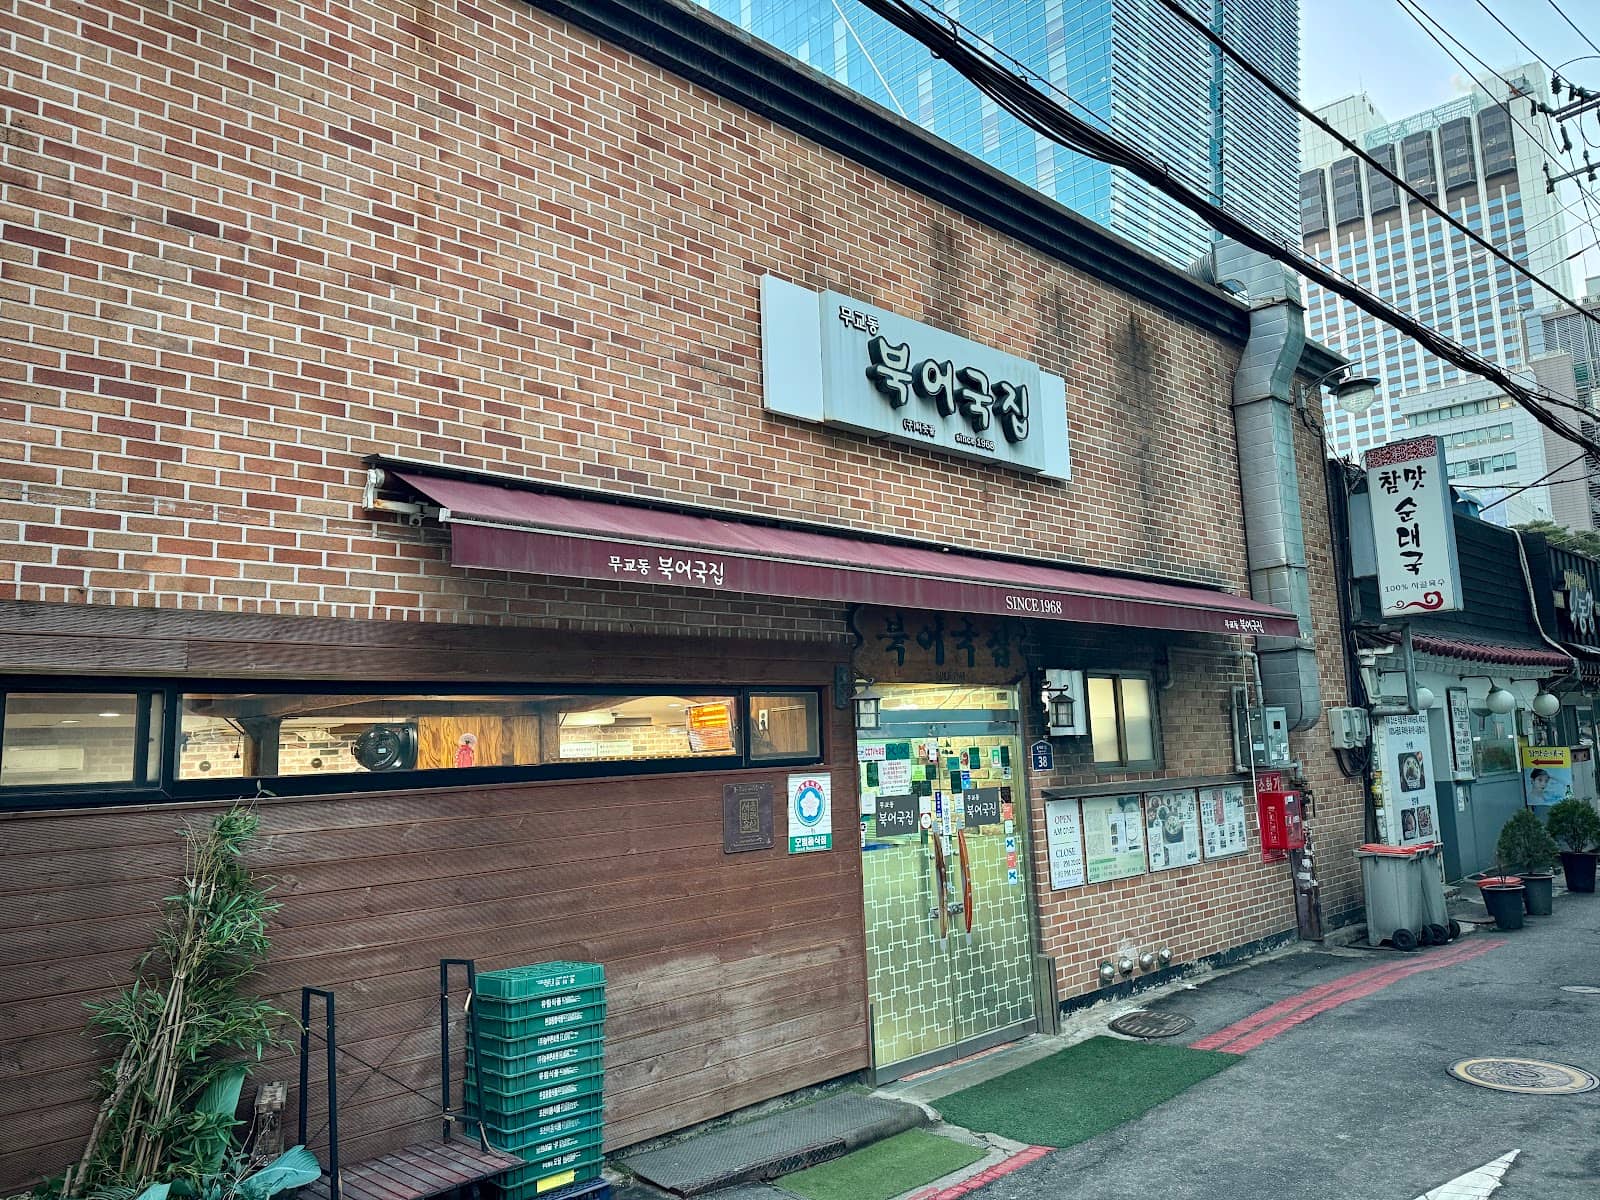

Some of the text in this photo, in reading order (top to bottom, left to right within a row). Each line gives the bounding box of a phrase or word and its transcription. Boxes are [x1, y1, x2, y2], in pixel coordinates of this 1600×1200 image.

[839, 306, 880, 336] 무교동
[866, 335, 1030, 443] 북어국집
[955, 432, 996, 451] since 1968
[1378, 465, 1426, 495] 참맛
[1394, 496, 1424, 576] 순대국
[608, 556, 725, 586] 무교동 북어국집
[1384, 583, 1408, 593] 100%
[1006, 596, 1062, 614] SINCE 1968
[1038, 756, 1048, 768] 38
[1258, 776, 1280, 792] 소화기
[879, 810, 914, 827] 북어국집
[967, 802, 997, 818] 북어국집
[1054, 814, 1072, 824] OPEN
[1054, 828, 1063, 836] AM
[1056, 847, 1076, 858] CLOSE
